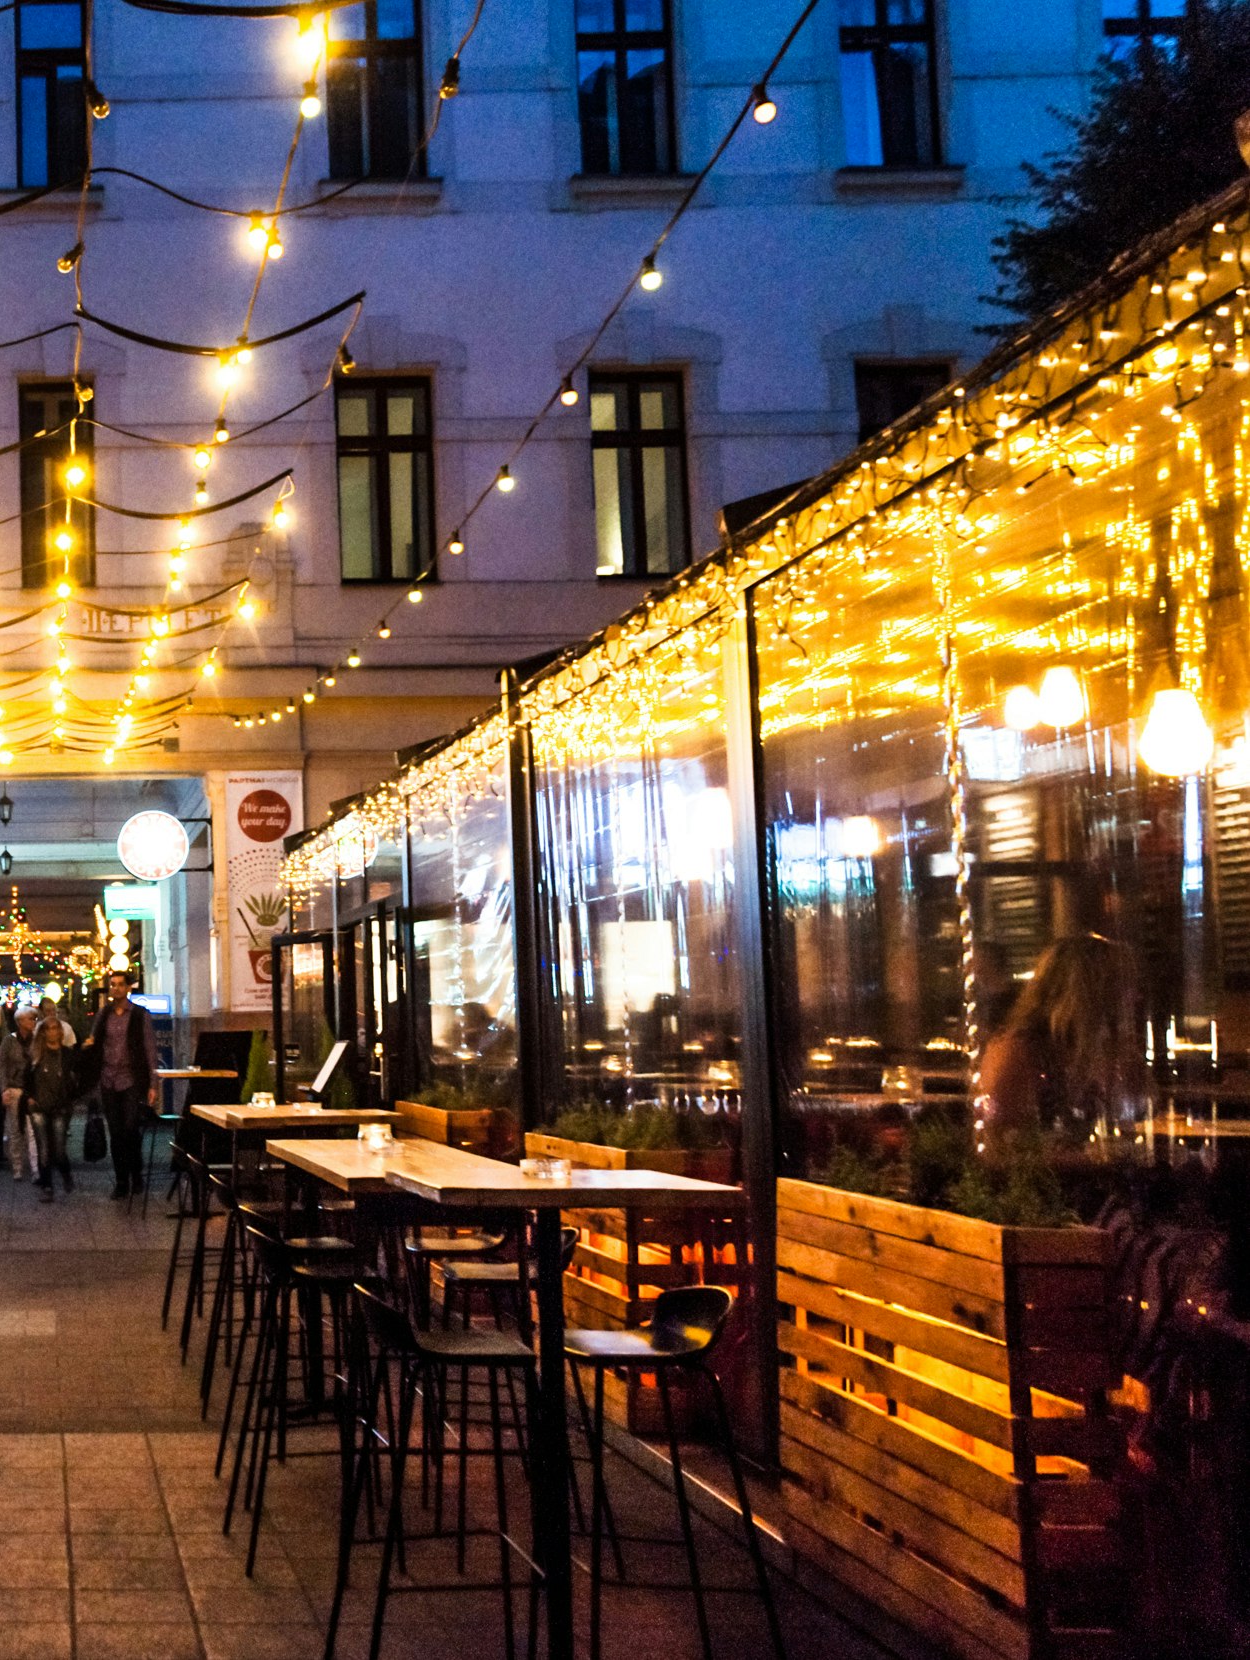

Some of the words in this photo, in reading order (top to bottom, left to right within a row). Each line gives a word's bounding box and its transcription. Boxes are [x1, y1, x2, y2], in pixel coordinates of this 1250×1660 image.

[242, 803, 258, 813] We
[259, 803, 287, 813] make
[241, 817, 265, 828] your
